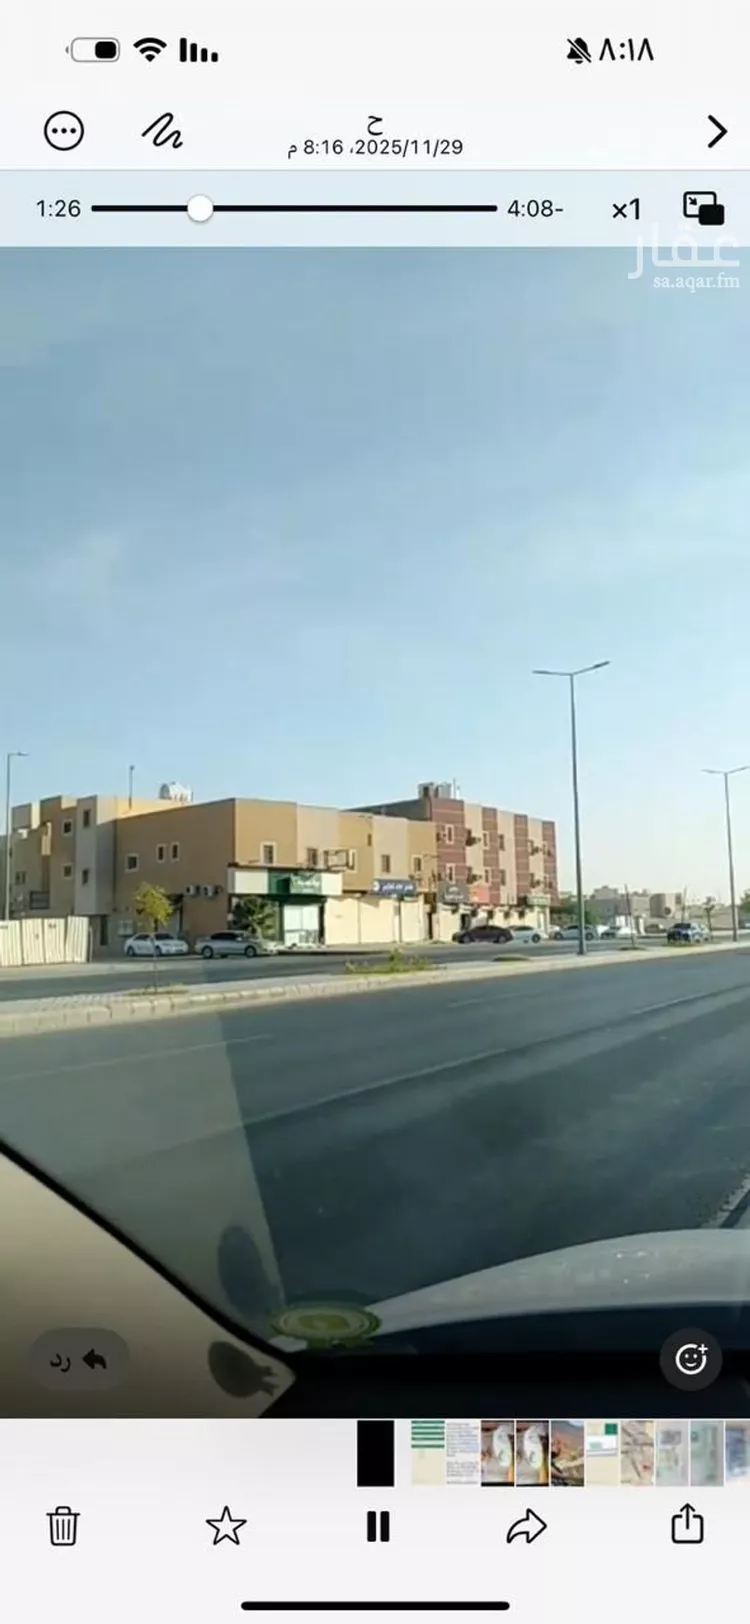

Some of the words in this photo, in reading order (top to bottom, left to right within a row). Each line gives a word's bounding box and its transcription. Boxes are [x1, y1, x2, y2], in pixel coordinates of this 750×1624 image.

[598, 37, 654, 61] ٨:١٨
[367, 115, 384, 136] ح
[287, 144, 298, 159] م
[303, 139, 344, 155] 8:16
[36, 199, 81, 218] 1:26
[507, 199, 564, 218] 4:08-
[49, 1353, 72, 1374] رد
